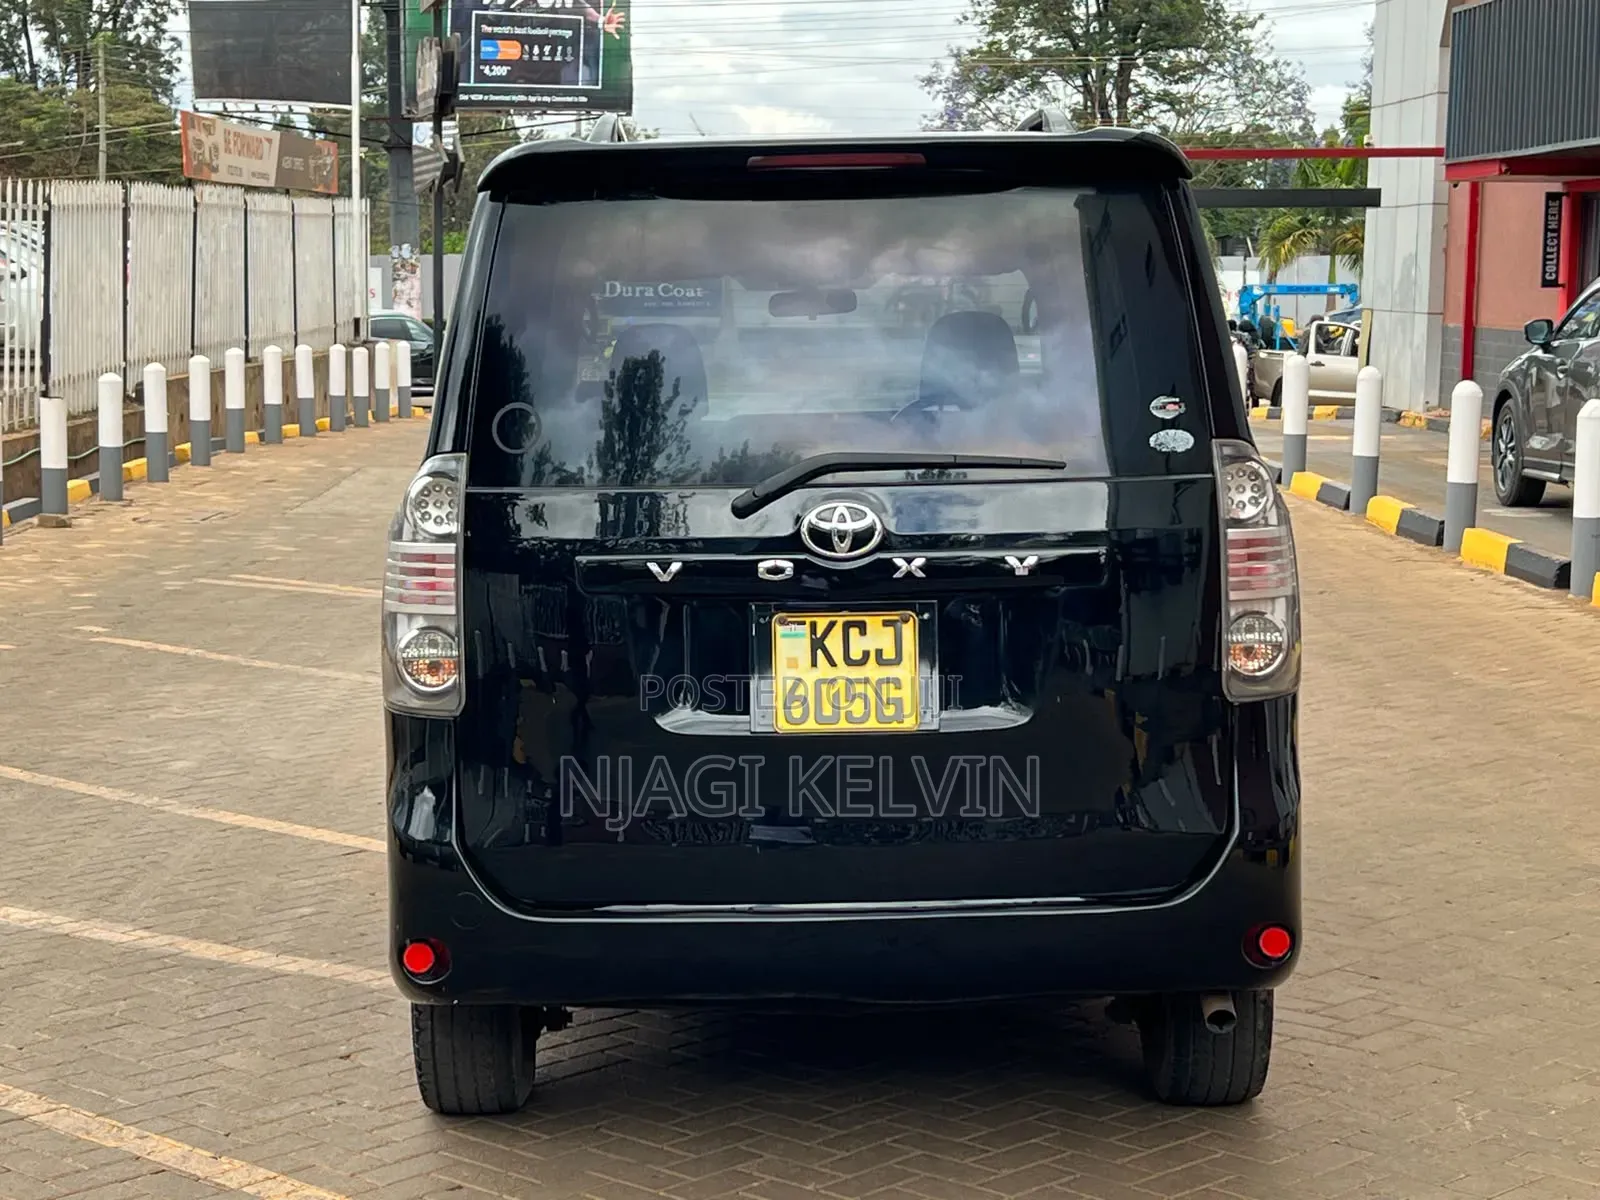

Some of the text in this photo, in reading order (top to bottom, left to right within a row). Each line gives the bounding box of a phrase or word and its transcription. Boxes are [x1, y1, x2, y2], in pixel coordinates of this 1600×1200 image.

[1545, 200, 1560, 280] COLLECT HERE
[809, 619, 904, 668] KCJ
[783, 676, 905, 726] 605G
